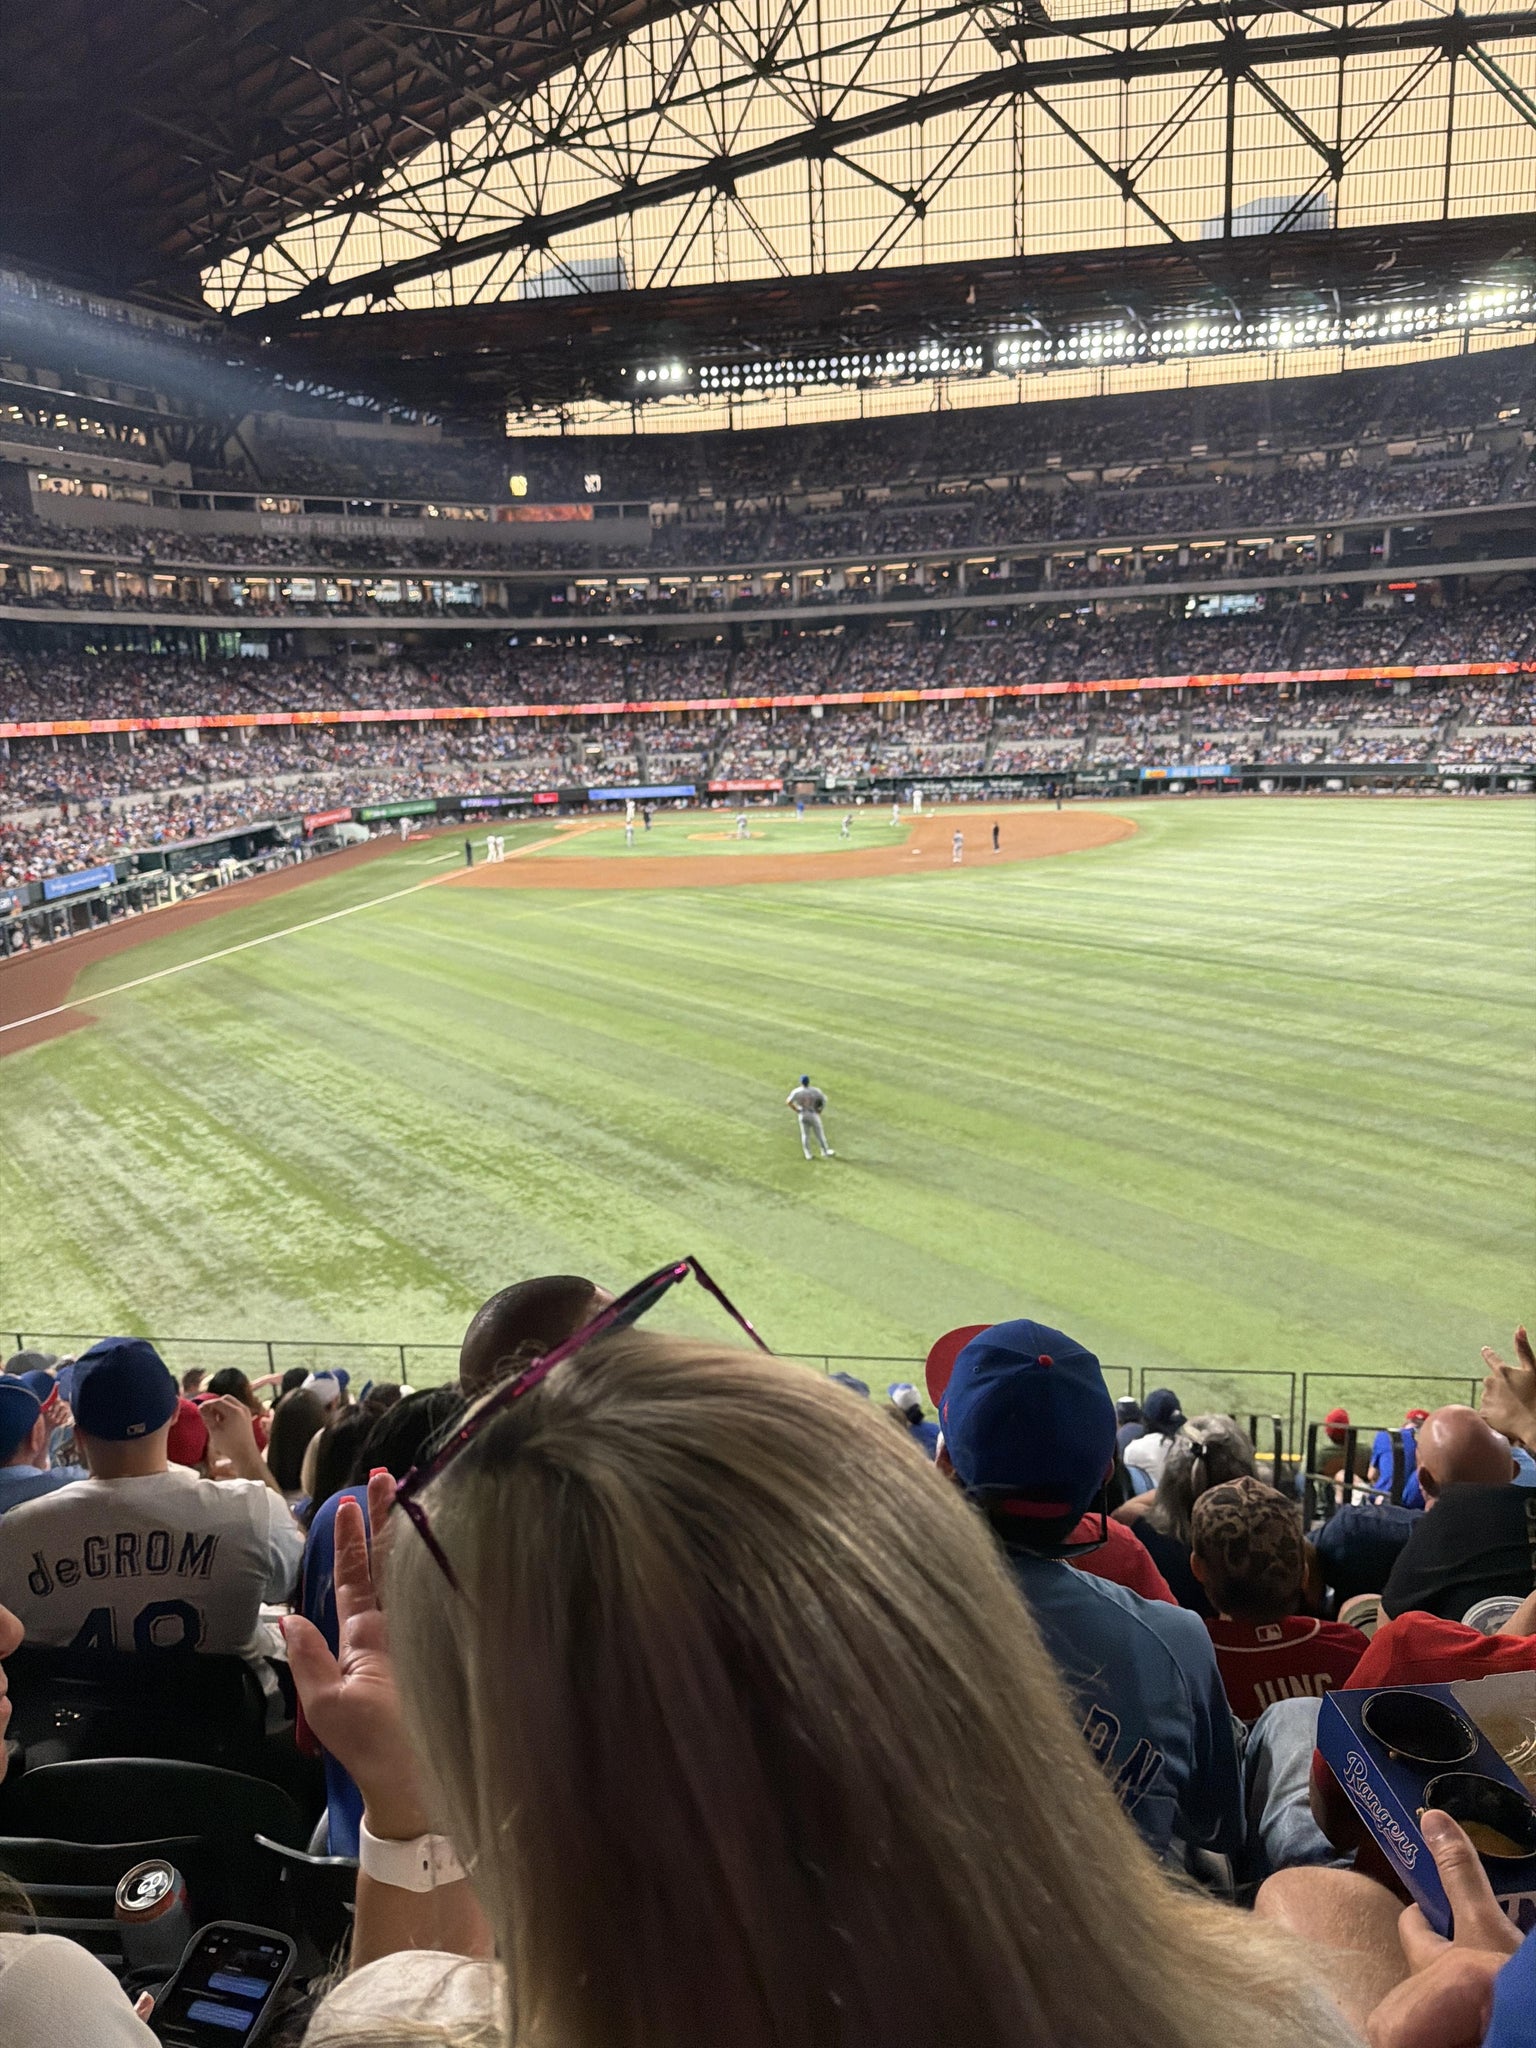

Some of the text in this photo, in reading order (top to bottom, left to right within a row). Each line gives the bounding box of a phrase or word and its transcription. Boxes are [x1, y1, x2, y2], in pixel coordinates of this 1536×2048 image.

[1438, 763, 1495, 774] VICTORY
[28, 1530, 219, 1596] deGROM
[1343, 1751, 1419, 1869] Rangers
